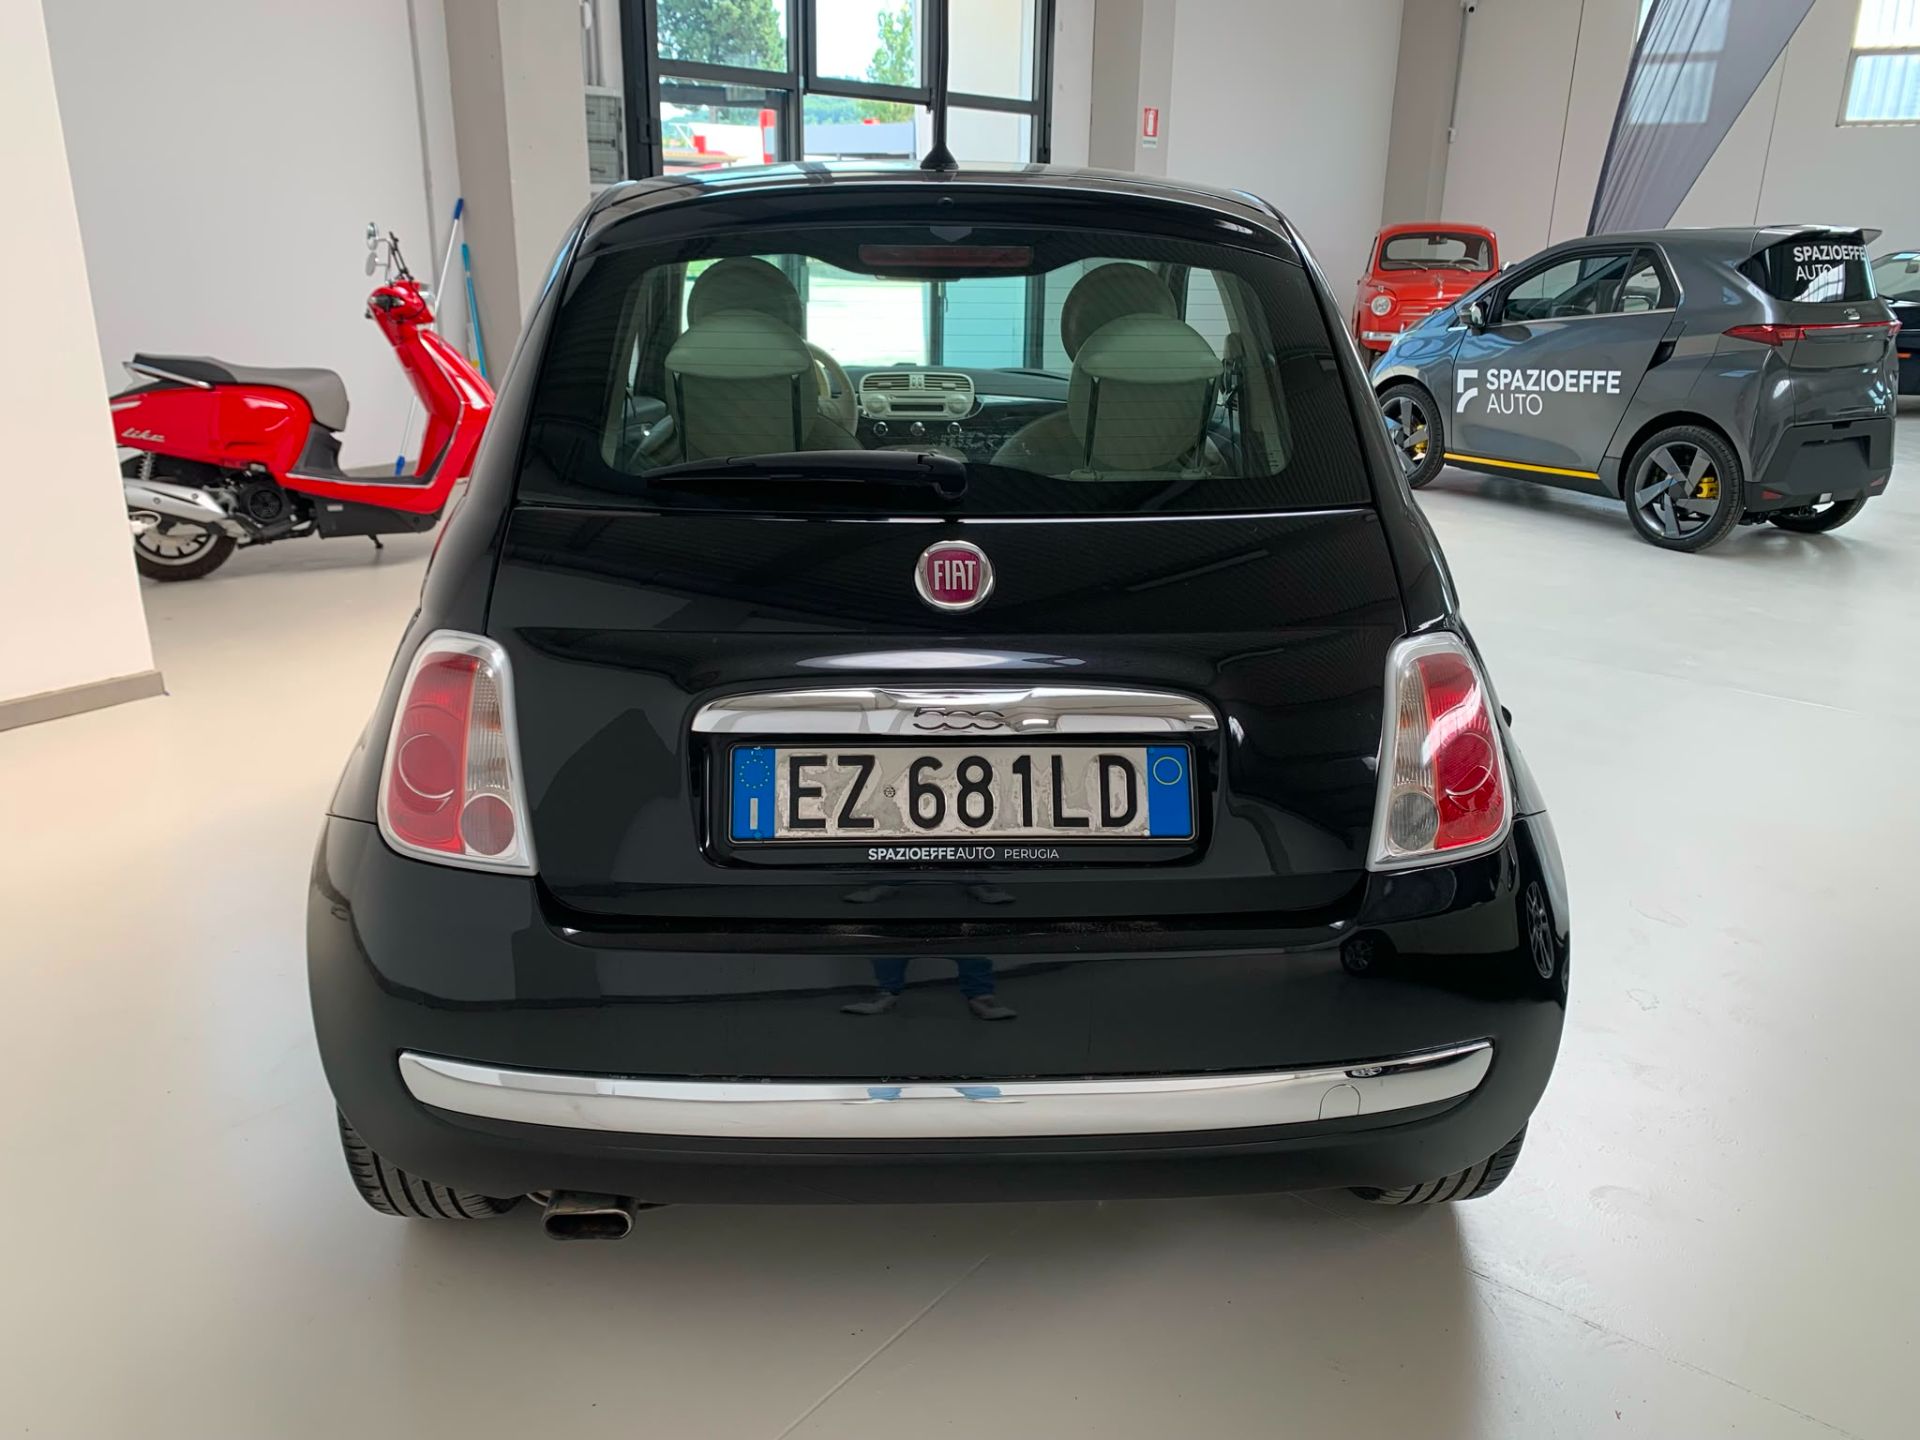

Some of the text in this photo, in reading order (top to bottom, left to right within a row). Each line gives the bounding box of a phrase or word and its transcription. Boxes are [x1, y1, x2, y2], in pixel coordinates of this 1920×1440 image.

[1793, 245, 1866, 262] SPAZIOEFFE
[1486, 368, 1622, 394] SPAZIOEFFE
[1486, 393, 1543, 415] AUTO
[934, 560, 976, 591] FIAT
[913, 706, 1004, 730] 500
[789, 754, 876, 829] EZ
[1004, 848, 1059, 859] PERUGIA
